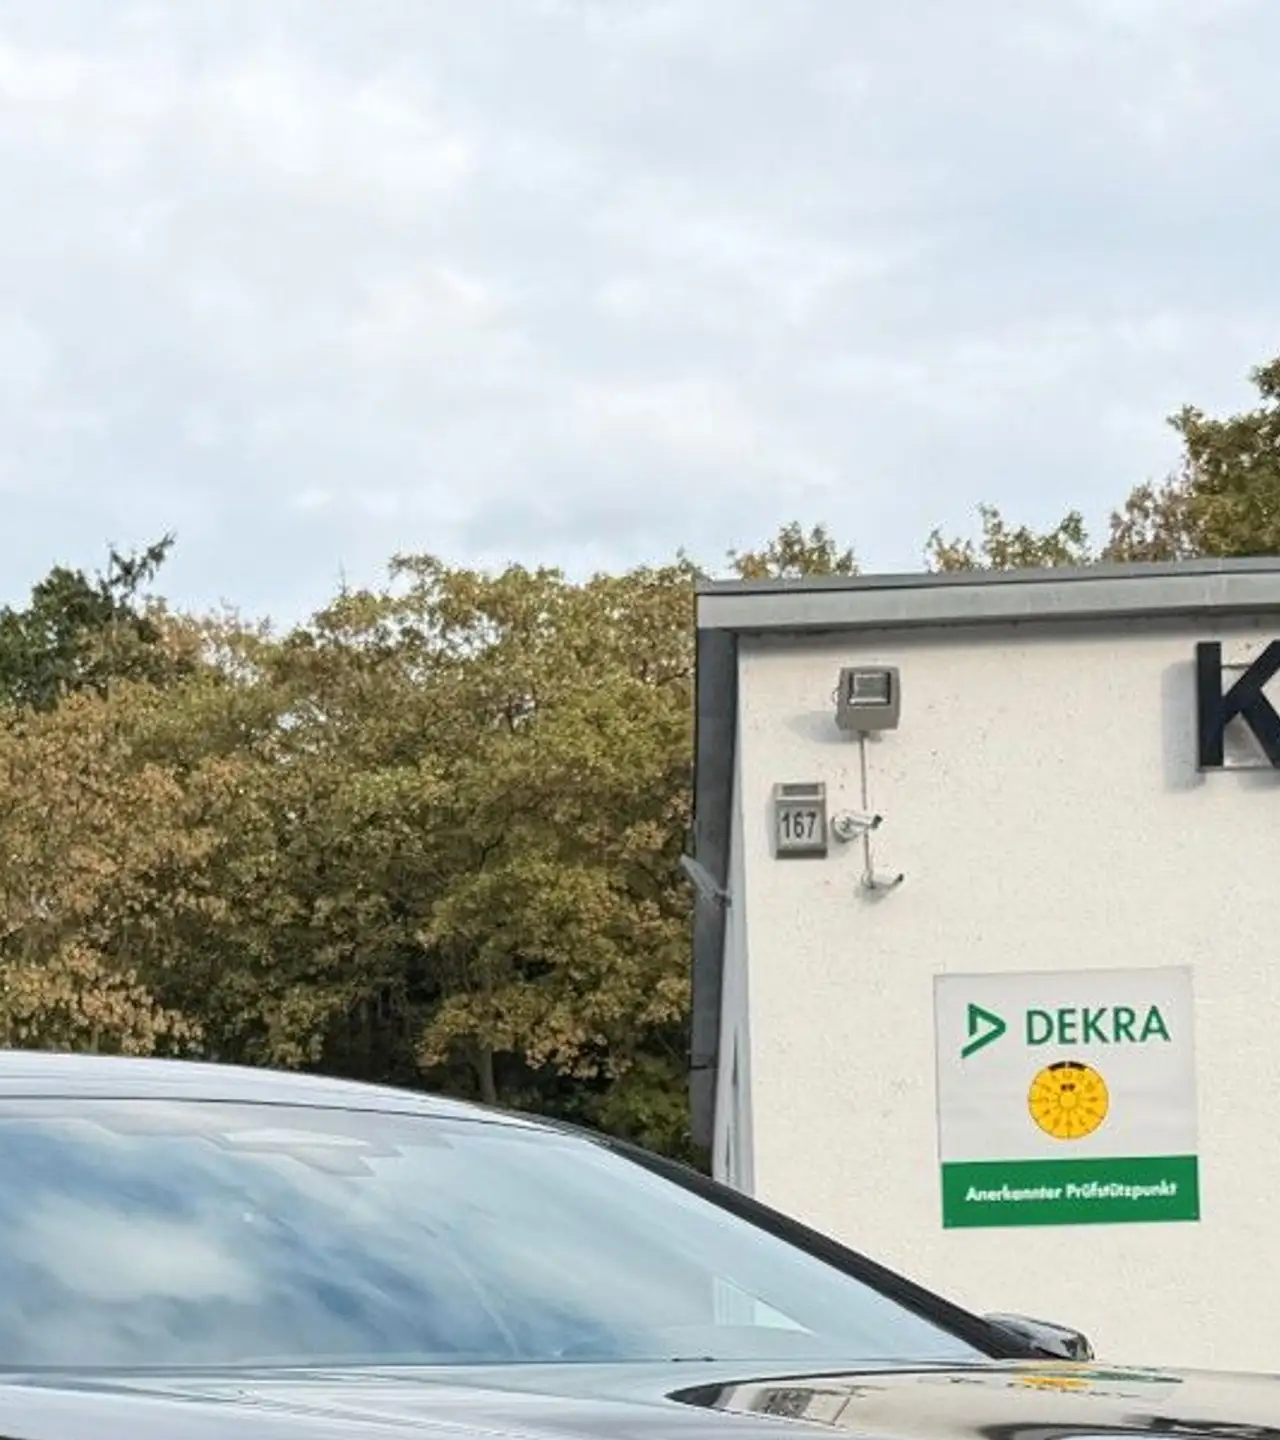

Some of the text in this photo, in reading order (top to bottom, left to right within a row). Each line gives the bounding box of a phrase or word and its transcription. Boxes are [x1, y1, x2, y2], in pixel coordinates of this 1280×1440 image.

[782, 811, 816, 839] 167
[1026, 1005, 1171, 1045] DEKRA
[966, 1178, 1178, 1202] Anerkannter Prüfstützpunkt
